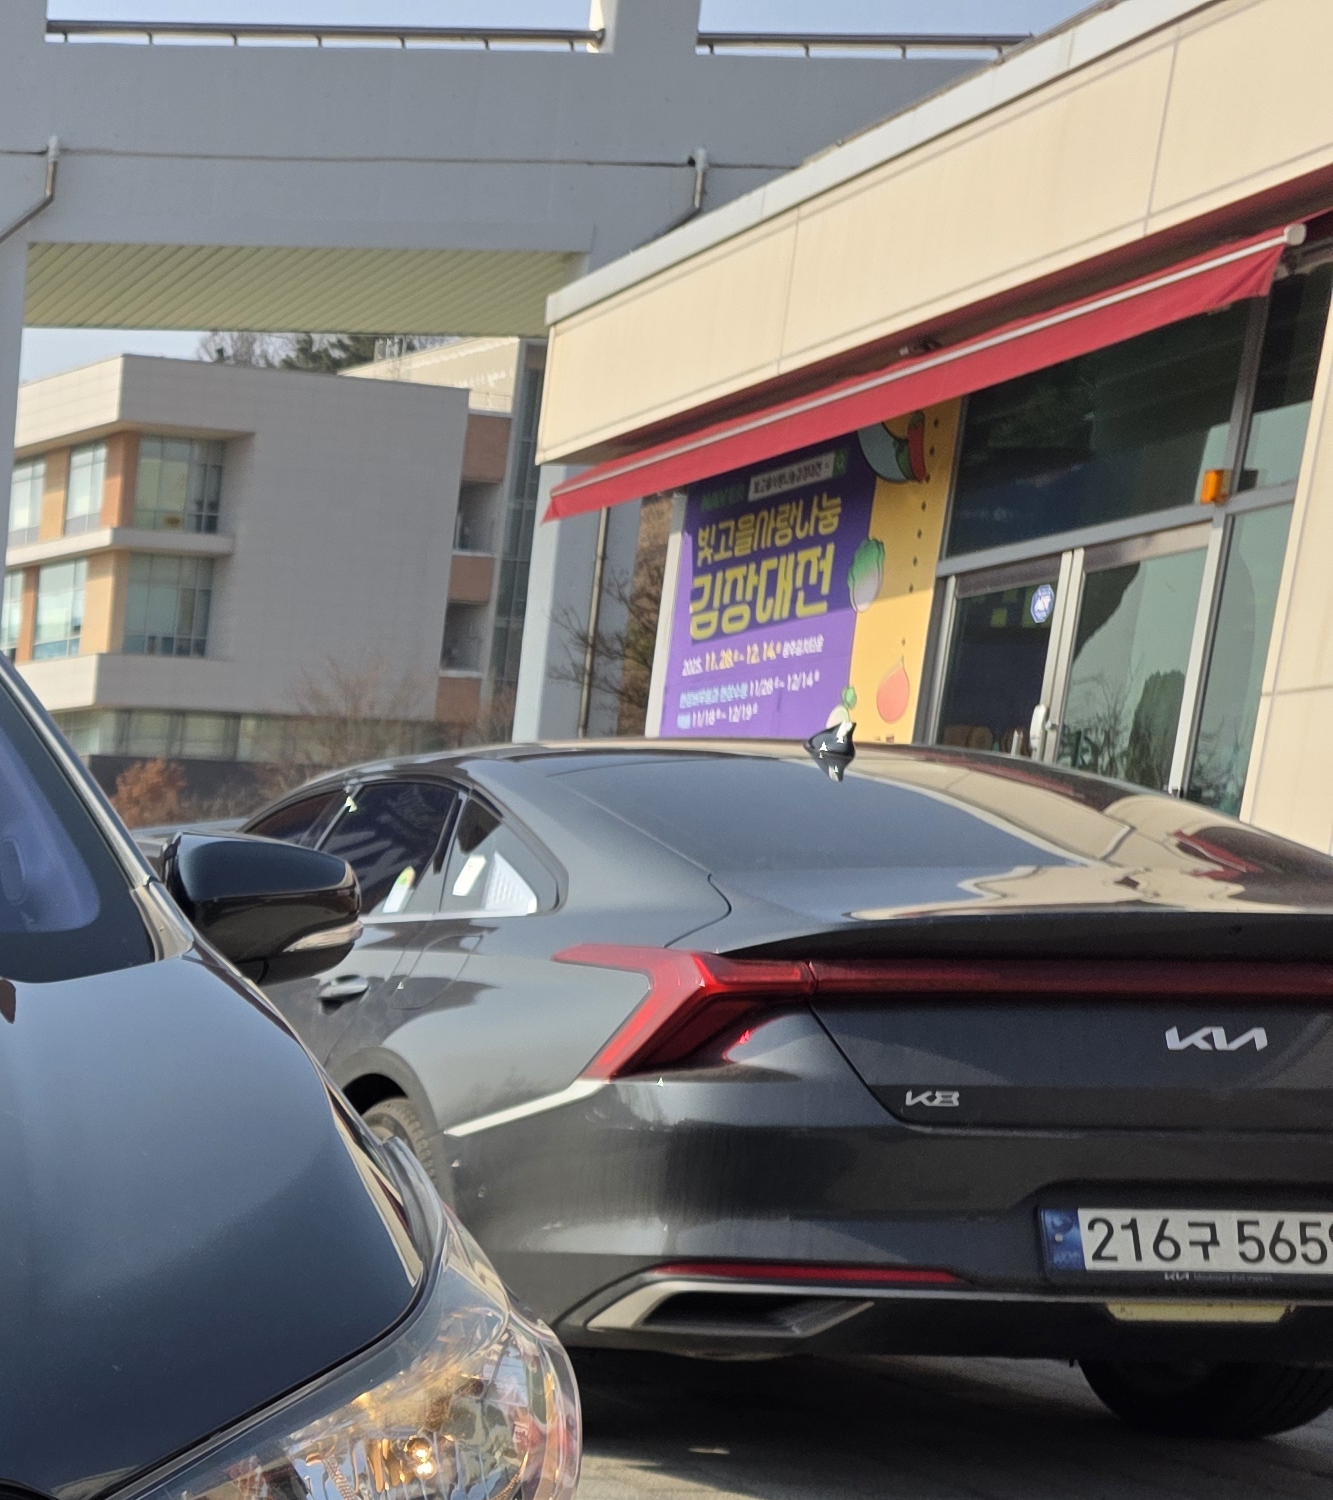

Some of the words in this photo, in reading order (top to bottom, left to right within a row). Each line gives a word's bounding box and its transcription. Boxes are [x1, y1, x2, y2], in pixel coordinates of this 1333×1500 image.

[690, 542, 835, 640] 김장대전
[905, 1089, 960, 1108] K8
[1087, 1217, 1220, 1262] 216구
[1236, 1219, 1333, 1265] 565
